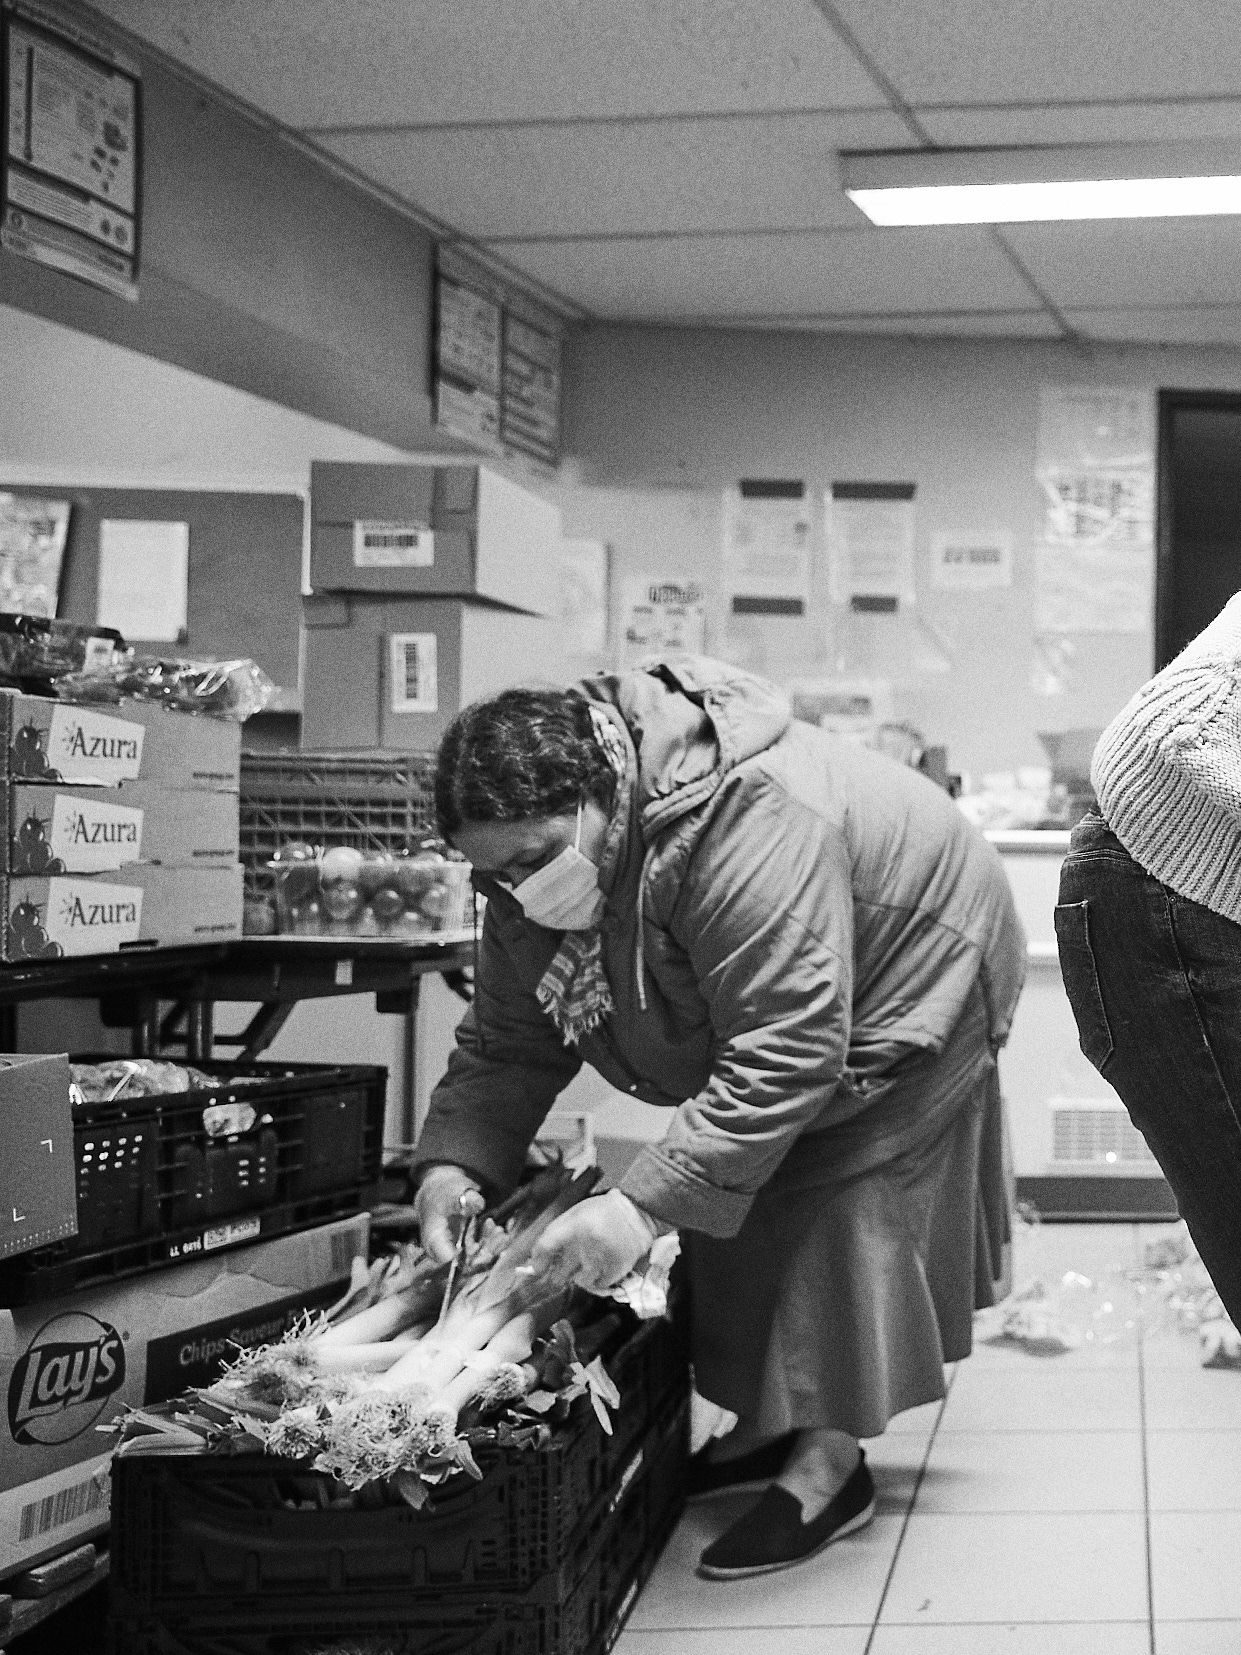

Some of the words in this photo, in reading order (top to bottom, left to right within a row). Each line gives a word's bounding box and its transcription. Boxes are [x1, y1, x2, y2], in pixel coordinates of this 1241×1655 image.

[71, 727, 137, 760] Azura
[74, 814, 137, 844] Azura
[70, 897, 137, 927] Azura
[180, 1336, 225, 1366] Chips
[15, 1334, 119, 1423] Lay's
